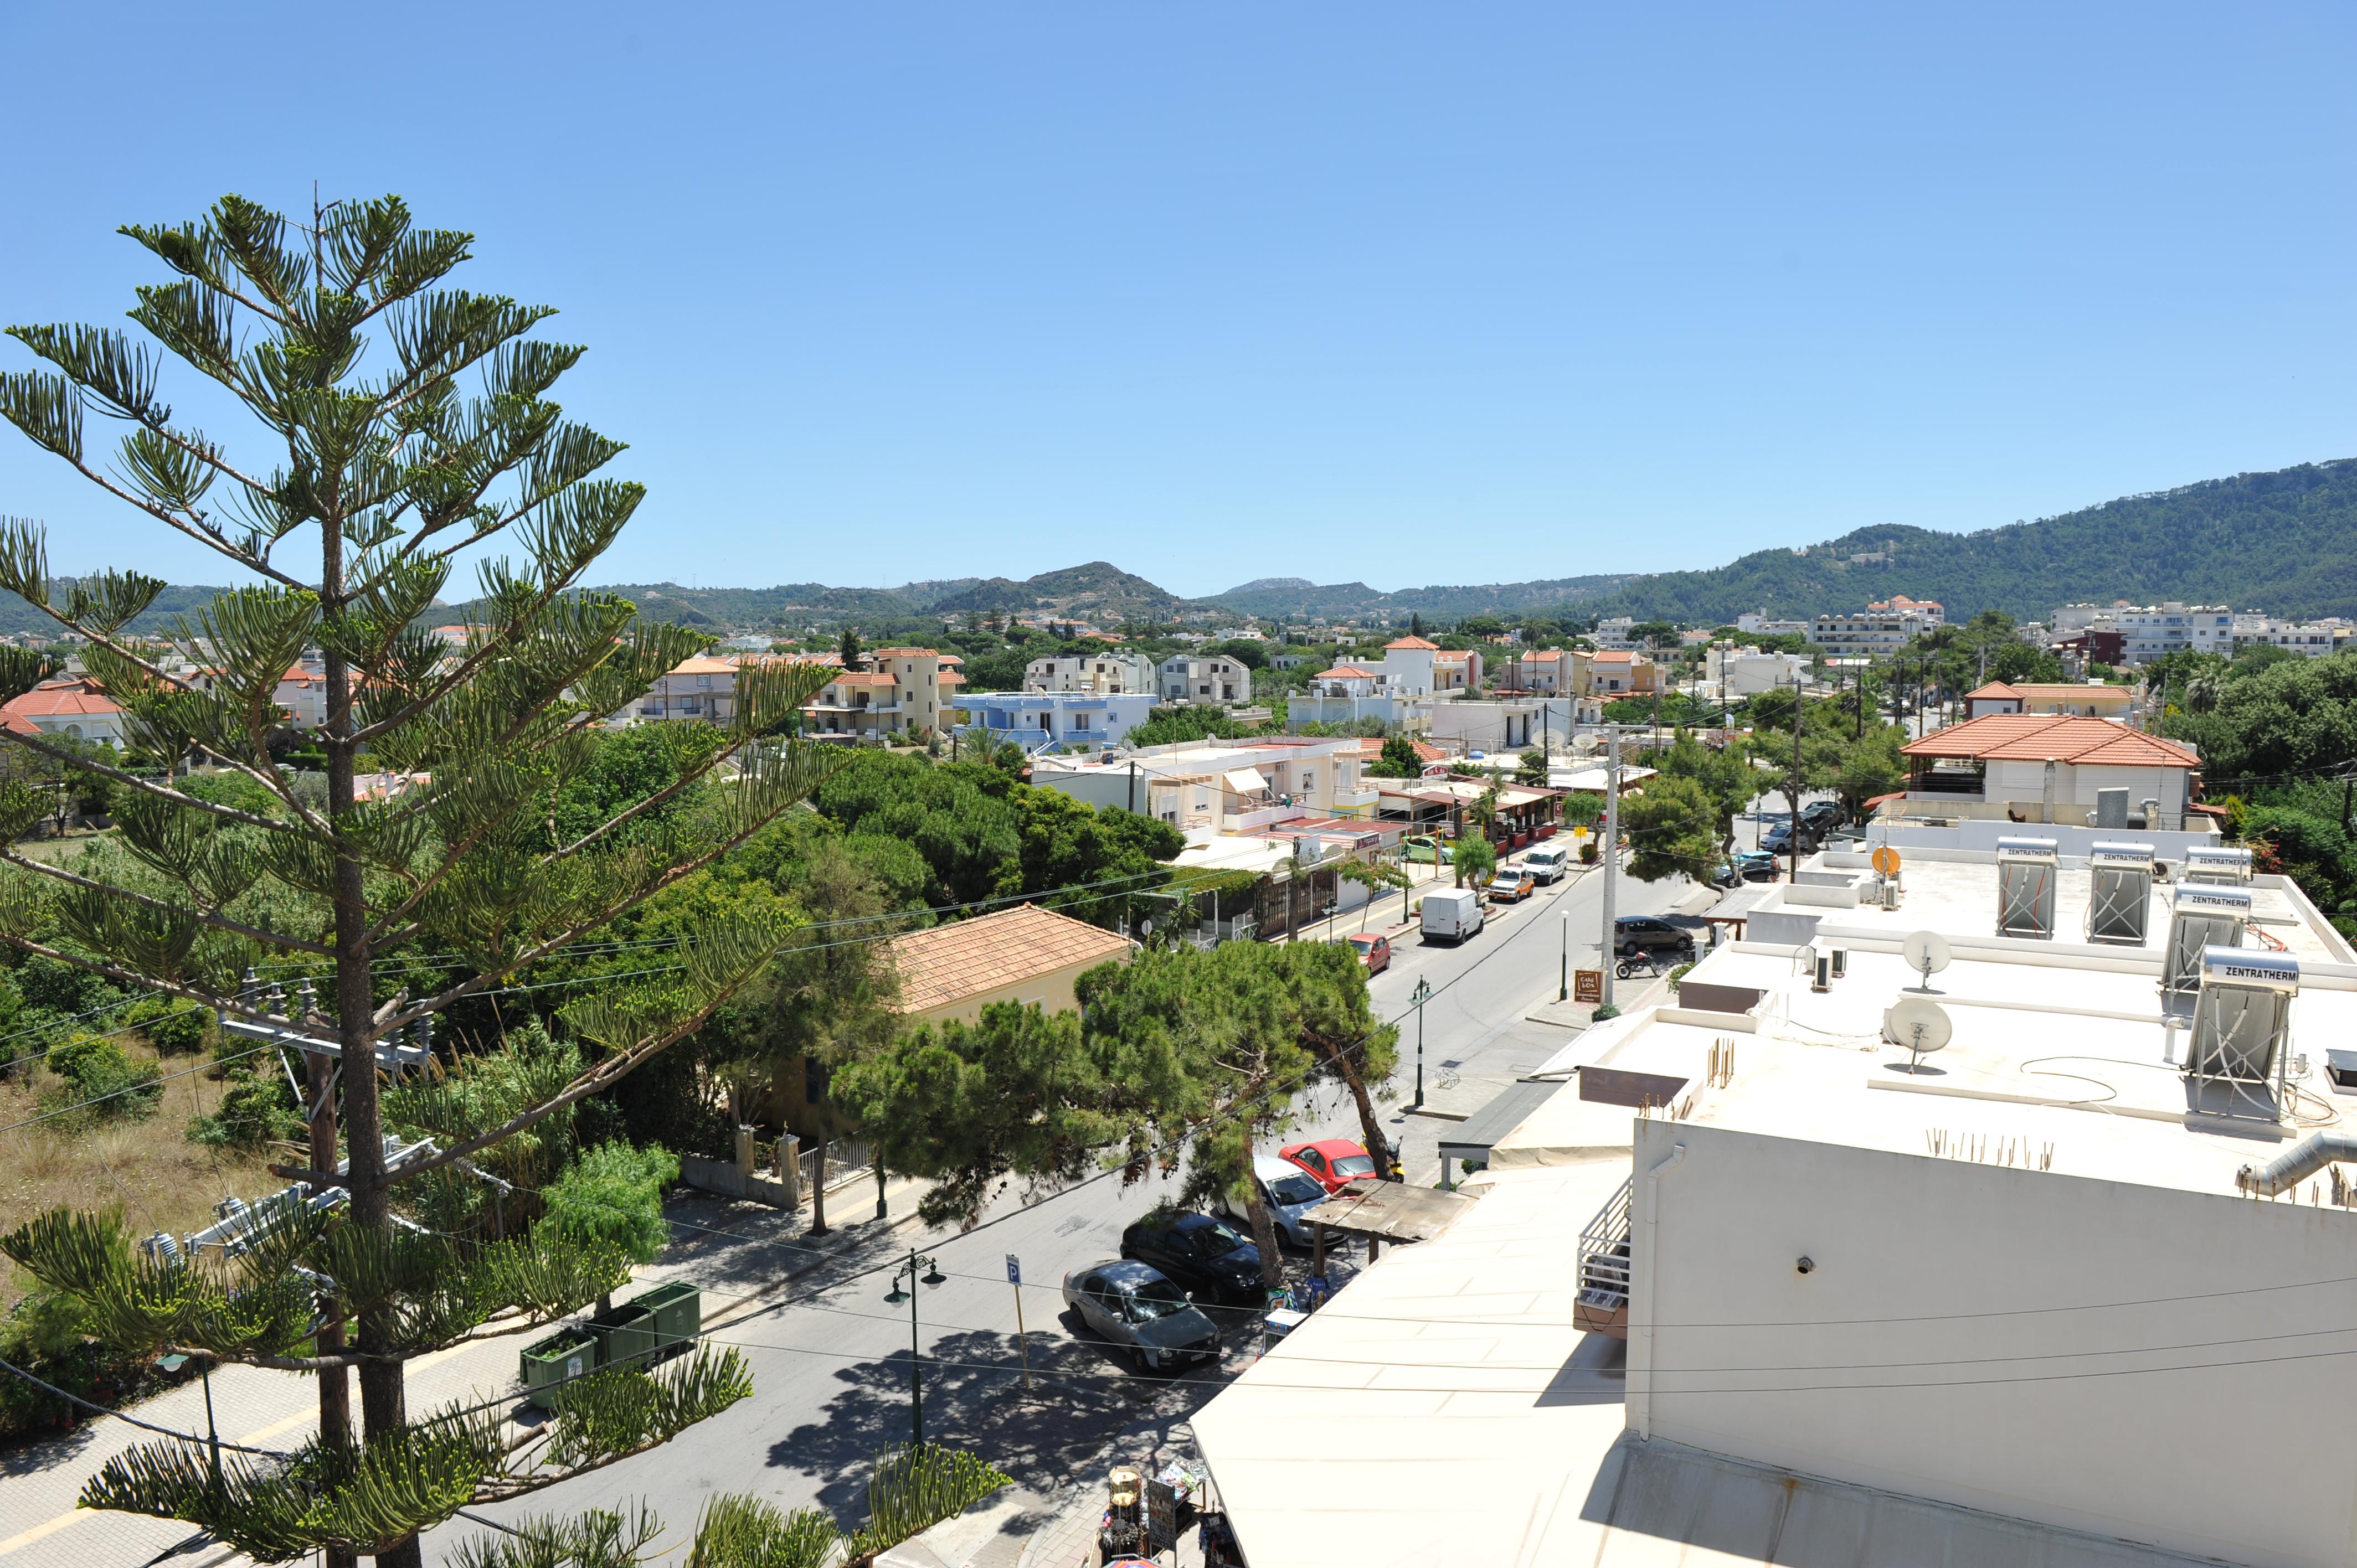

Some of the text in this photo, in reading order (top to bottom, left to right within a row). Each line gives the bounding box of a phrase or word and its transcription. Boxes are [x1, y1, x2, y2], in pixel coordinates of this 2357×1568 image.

[2104, 854, 2149, 862] ZENTRATHERM
[2193, 896, 2247, 907] ZENTRATHERM
[2226, 967, 2296, 982] ZENTRATHERM
[1010, 1265, 1017, 1280] P
